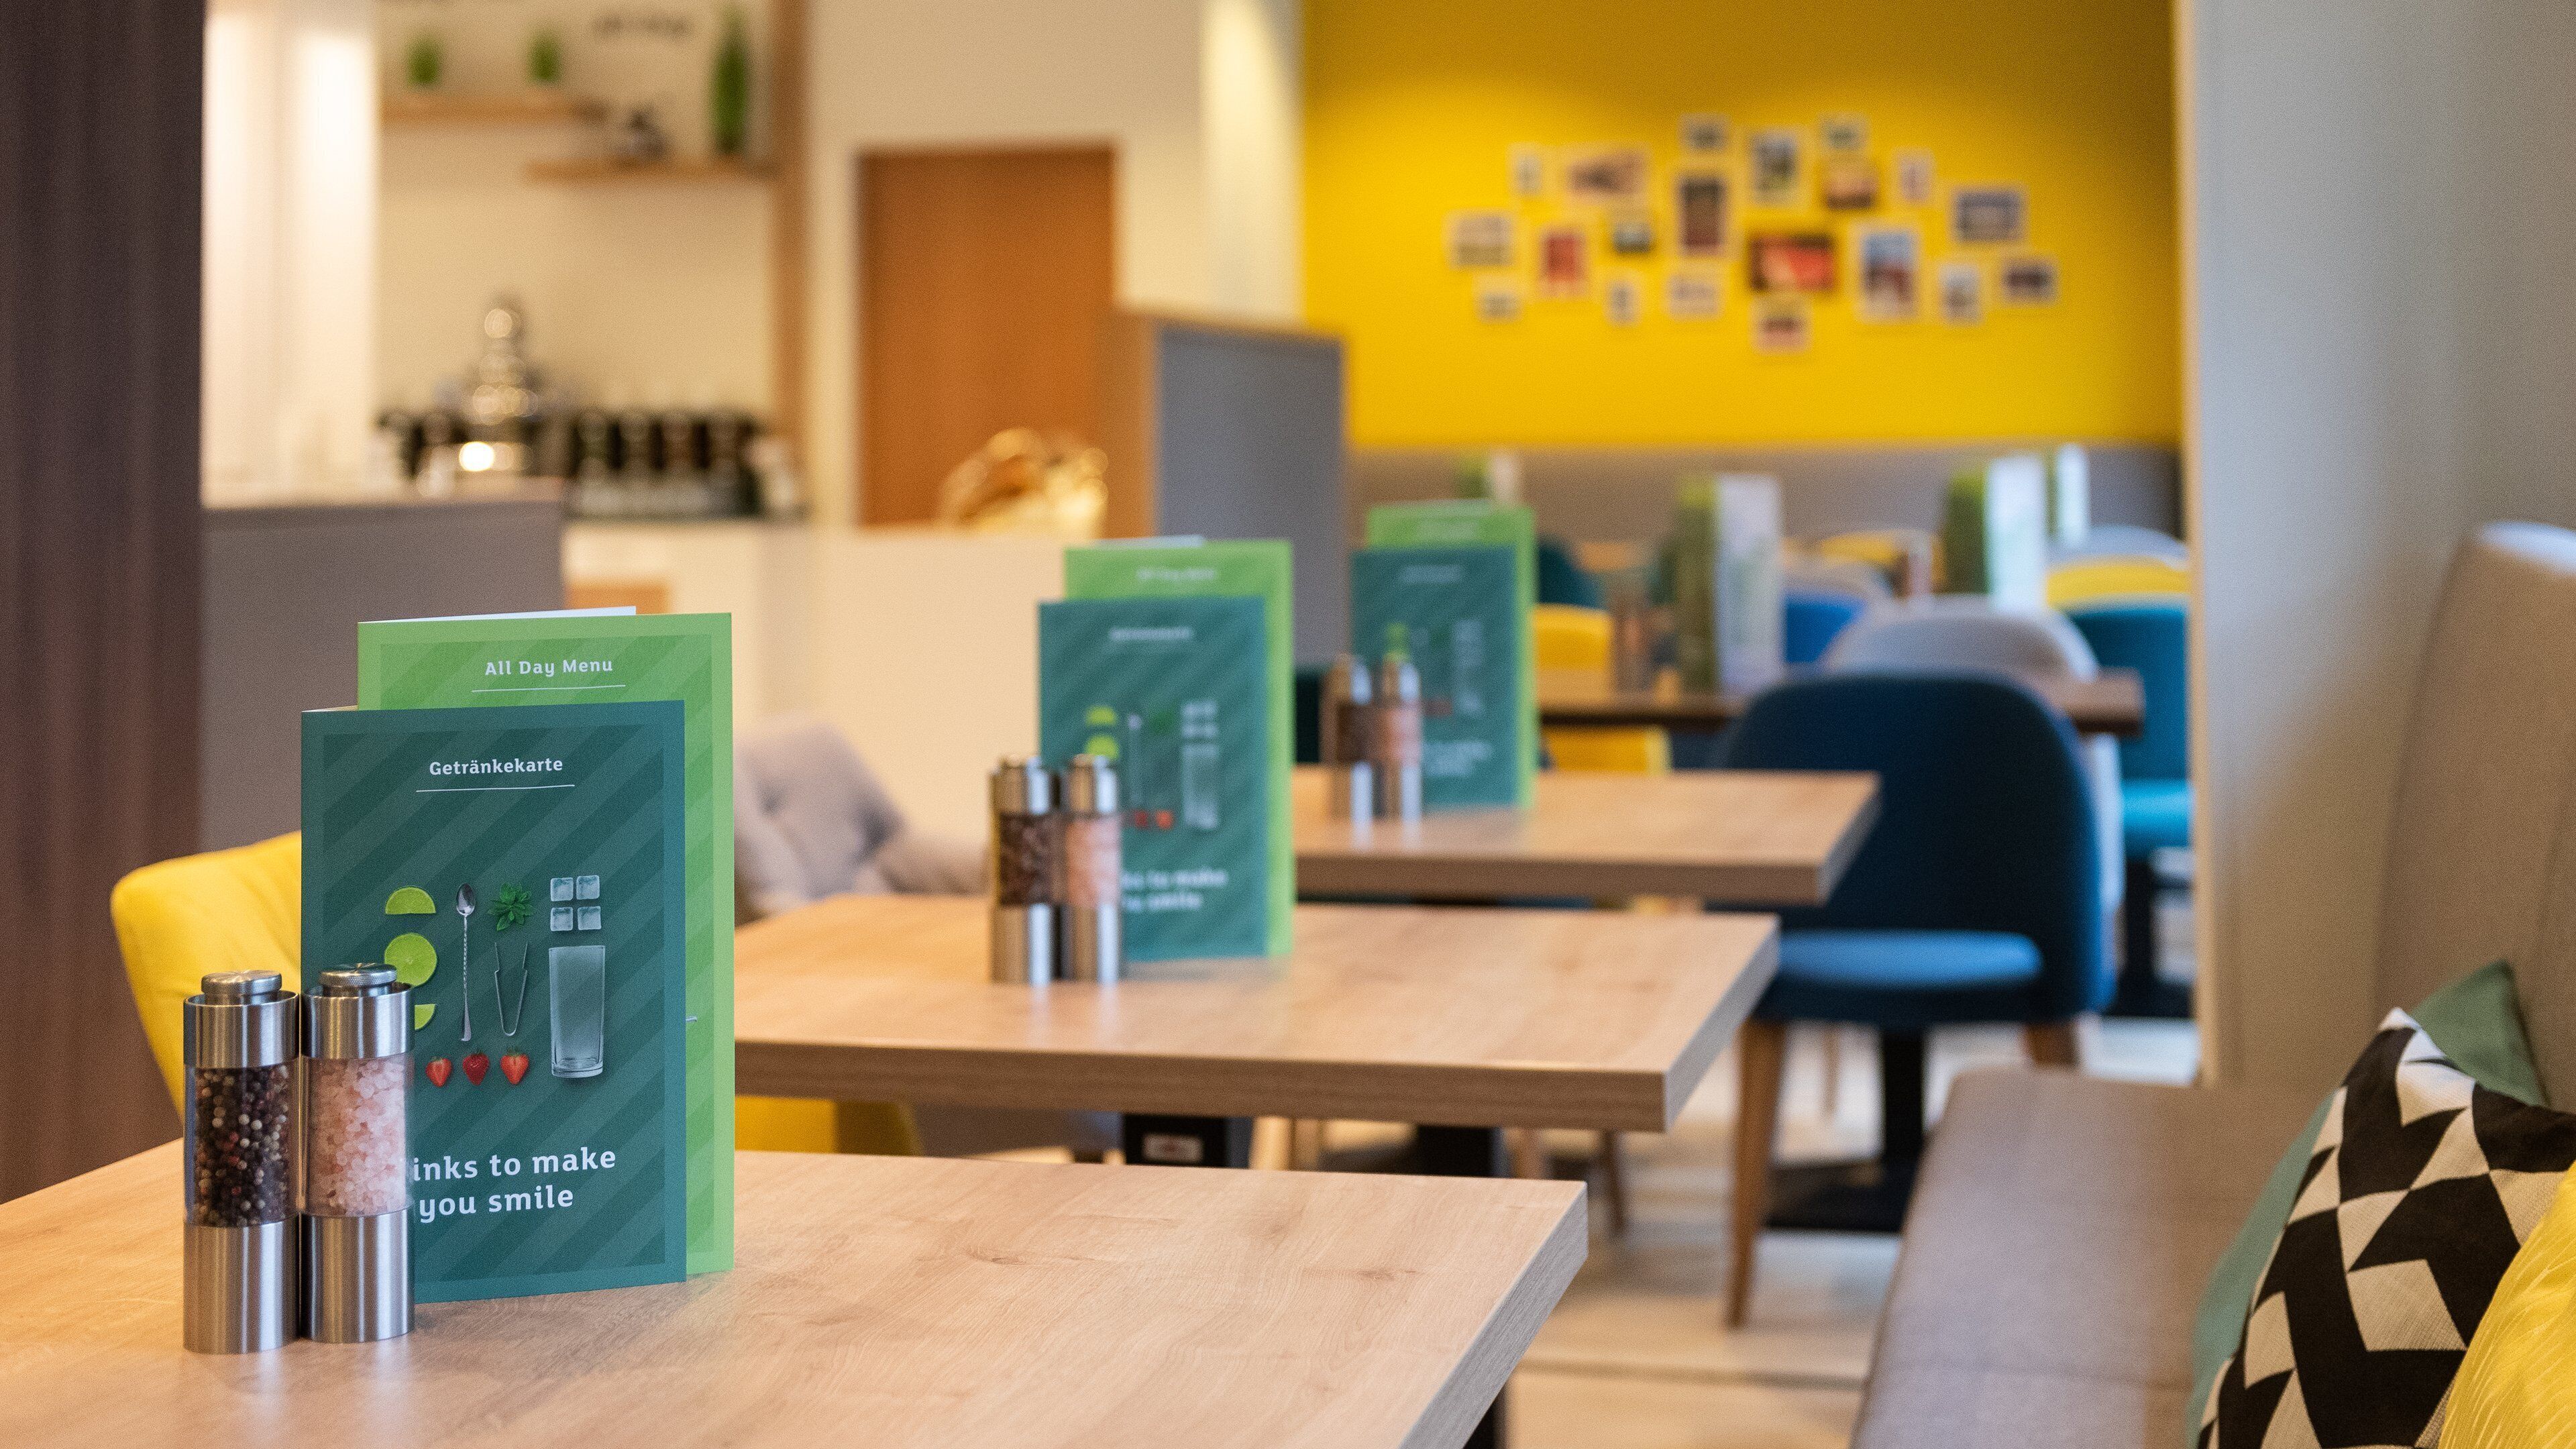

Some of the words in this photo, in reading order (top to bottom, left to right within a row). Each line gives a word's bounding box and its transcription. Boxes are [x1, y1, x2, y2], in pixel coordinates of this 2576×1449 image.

[484, 660, 512, 676] All
[519, 660, 555, 678] Day
[562, 659, 613, 674] Menu
[429, 757, 563, 775] Getränkekarte
[413, 1155, 478, 1181] inks
[489, 1154, 521, 1177] to
[532, 1146, 616, 1173] make
[419, 1196, 477, 1224] you
[488, 1184, 574, 1212] smile
